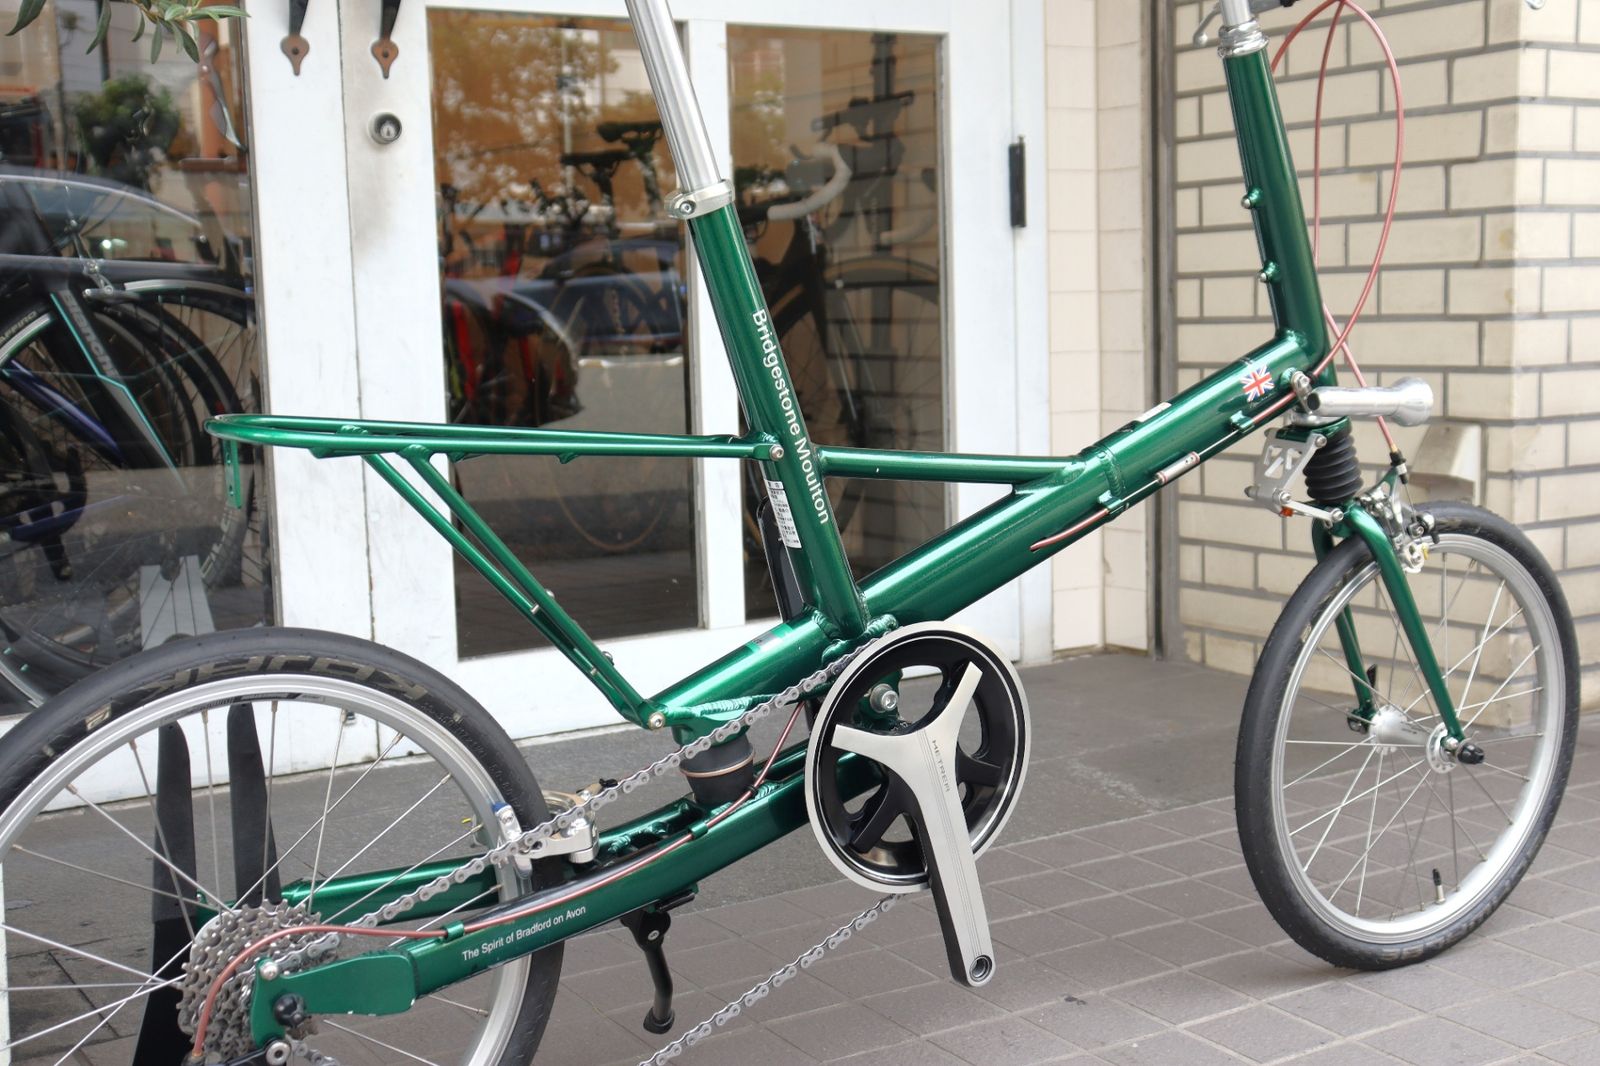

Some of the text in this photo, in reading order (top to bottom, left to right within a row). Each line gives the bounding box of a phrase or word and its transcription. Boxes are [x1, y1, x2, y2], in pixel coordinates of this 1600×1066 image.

[753, 309, 800, 436] Bridgestone
[794, 437, 829, 524] Moulton
[127, 655, 428, 701] KOJAK
[462, 905, 586, 961] The Spirit of Bradford on Avon
